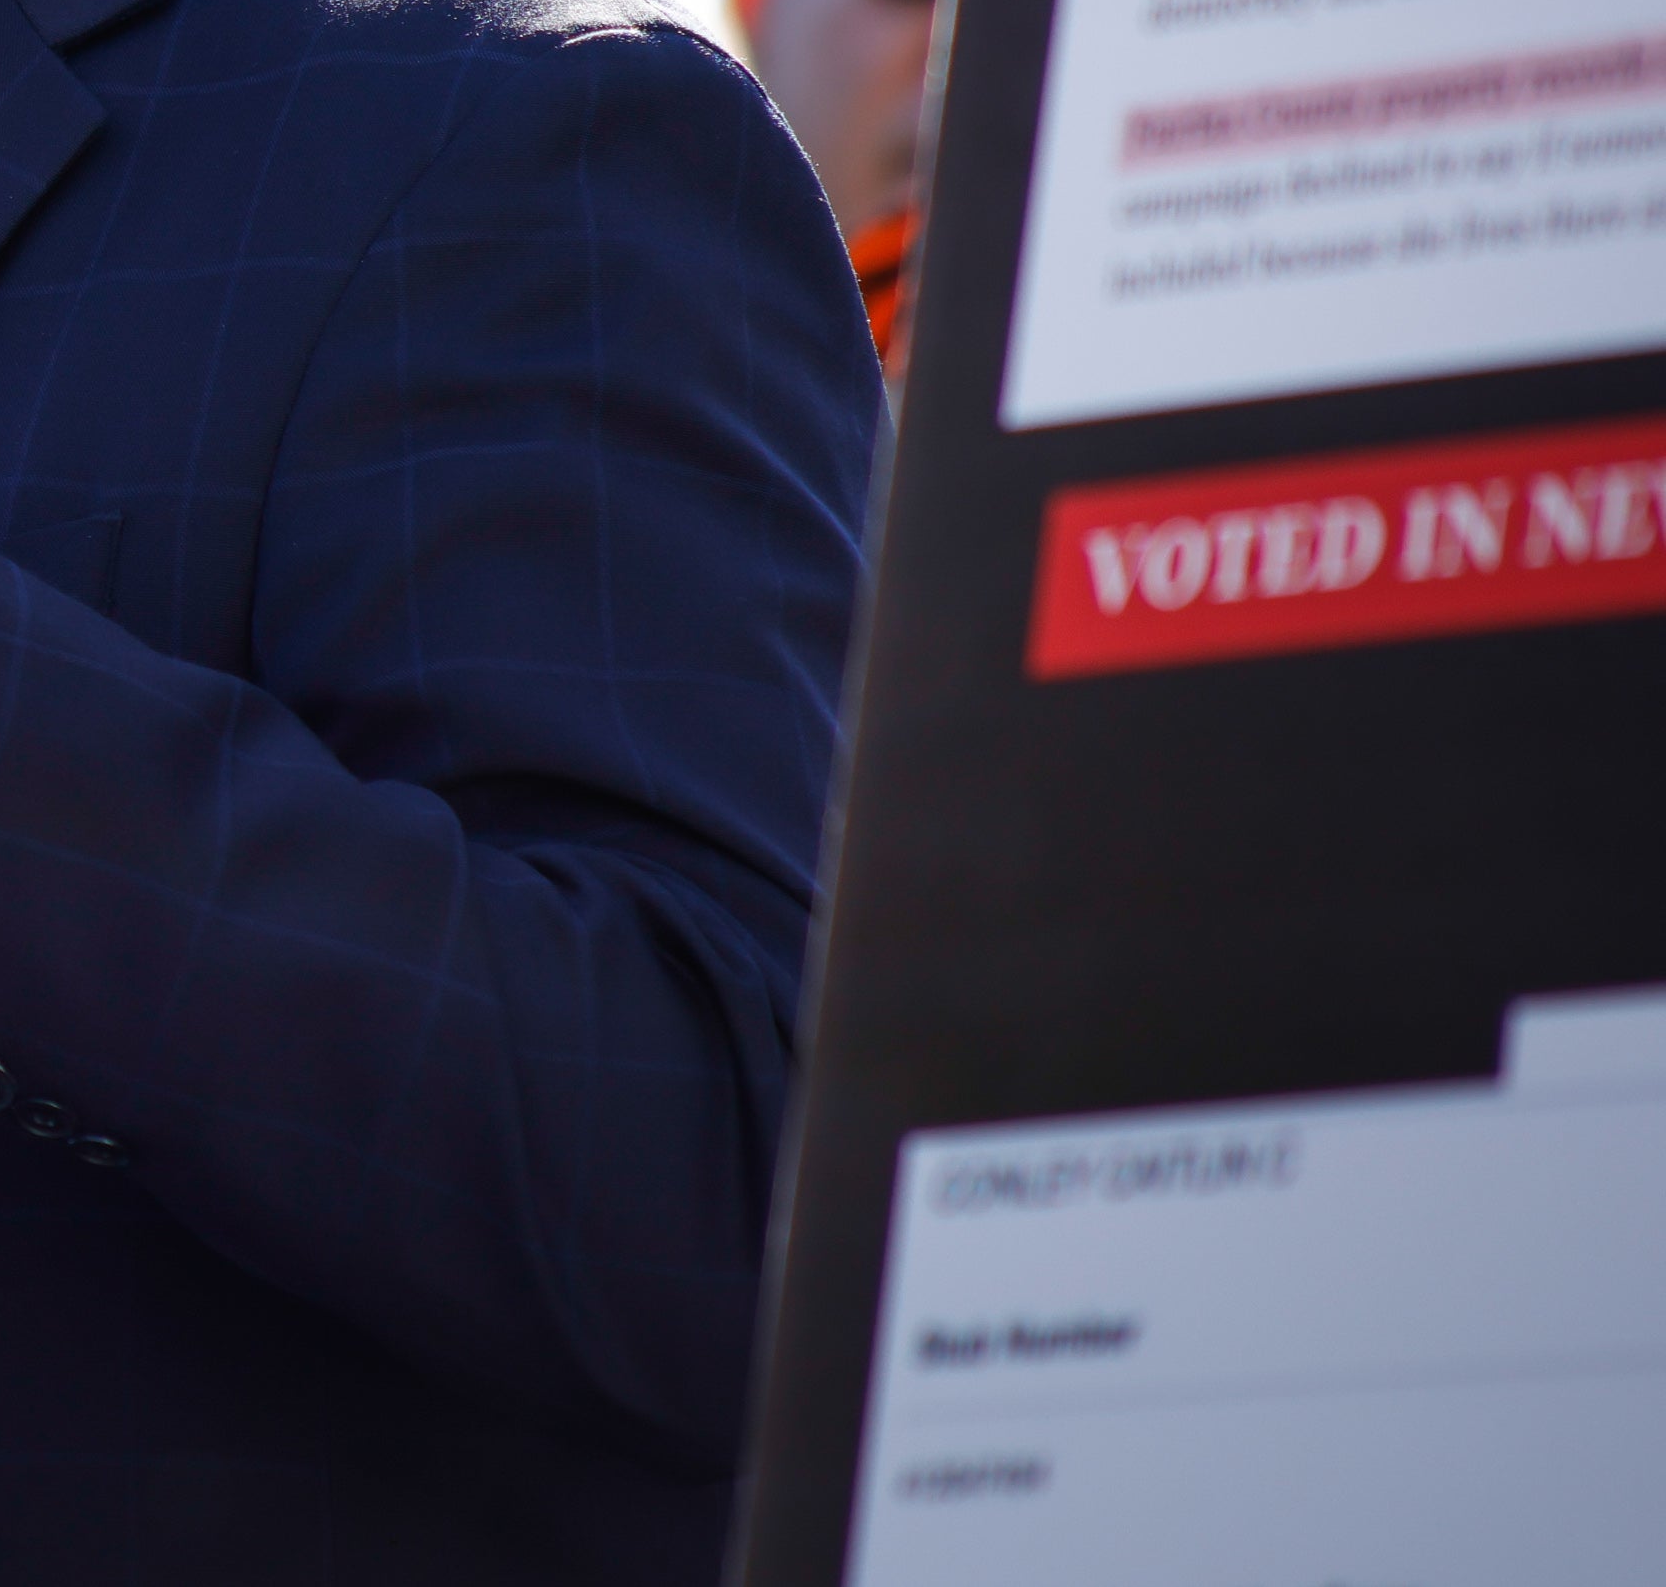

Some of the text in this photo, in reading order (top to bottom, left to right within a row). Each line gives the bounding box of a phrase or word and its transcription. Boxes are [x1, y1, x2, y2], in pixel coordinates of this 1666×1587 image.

[1083, 458, 1666, 617] VOTED IN NE
